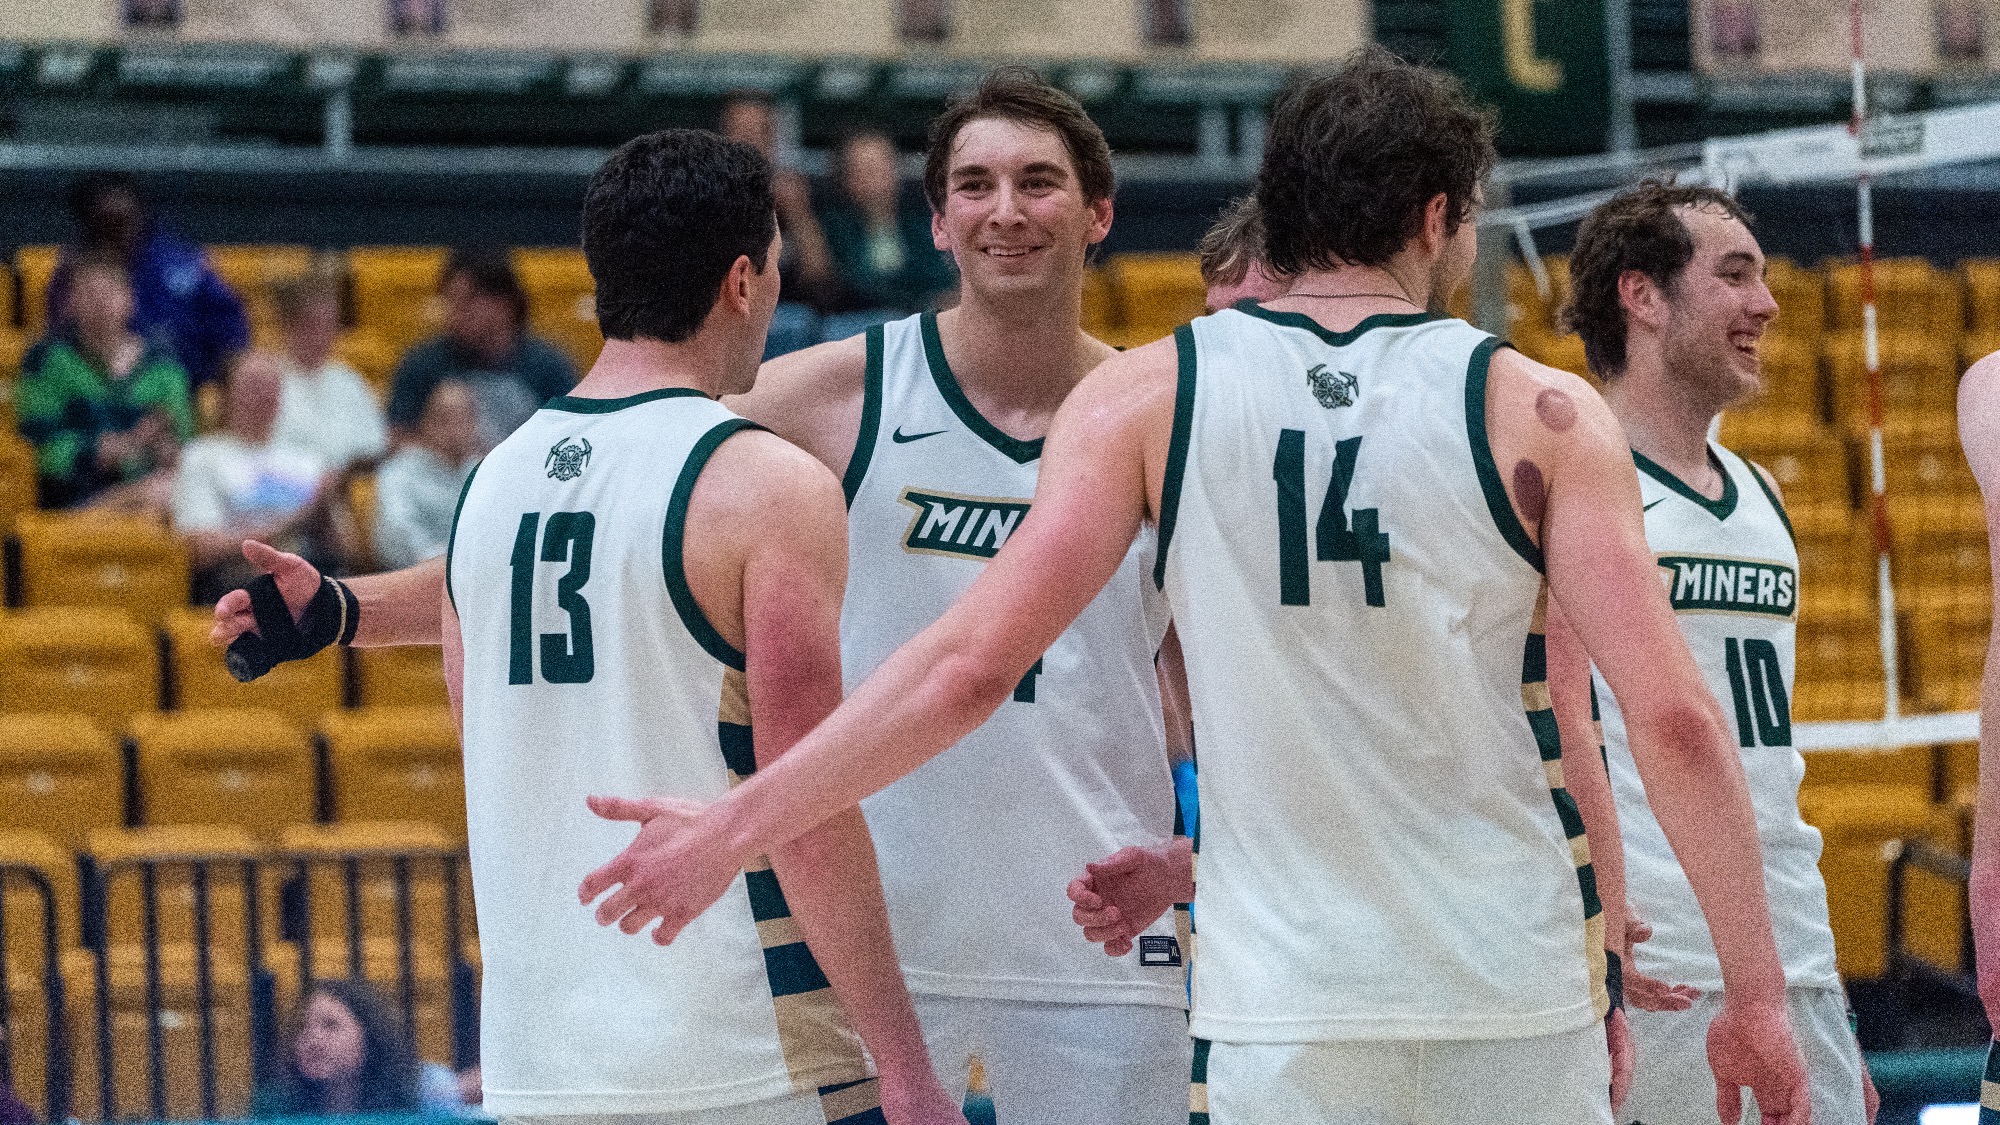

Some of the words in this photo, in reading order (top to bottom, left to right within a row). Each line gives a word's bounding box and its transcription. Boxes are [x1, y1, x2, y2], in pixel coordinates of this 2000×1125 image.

[918, 501, 1021, 549] MIN
[1273, 428, 1390, 607] 14
[509, 511, 595, 685] 13
[1674, 562, 1794, 608] MINERS
[1725, 637, 1792, 747] 10
